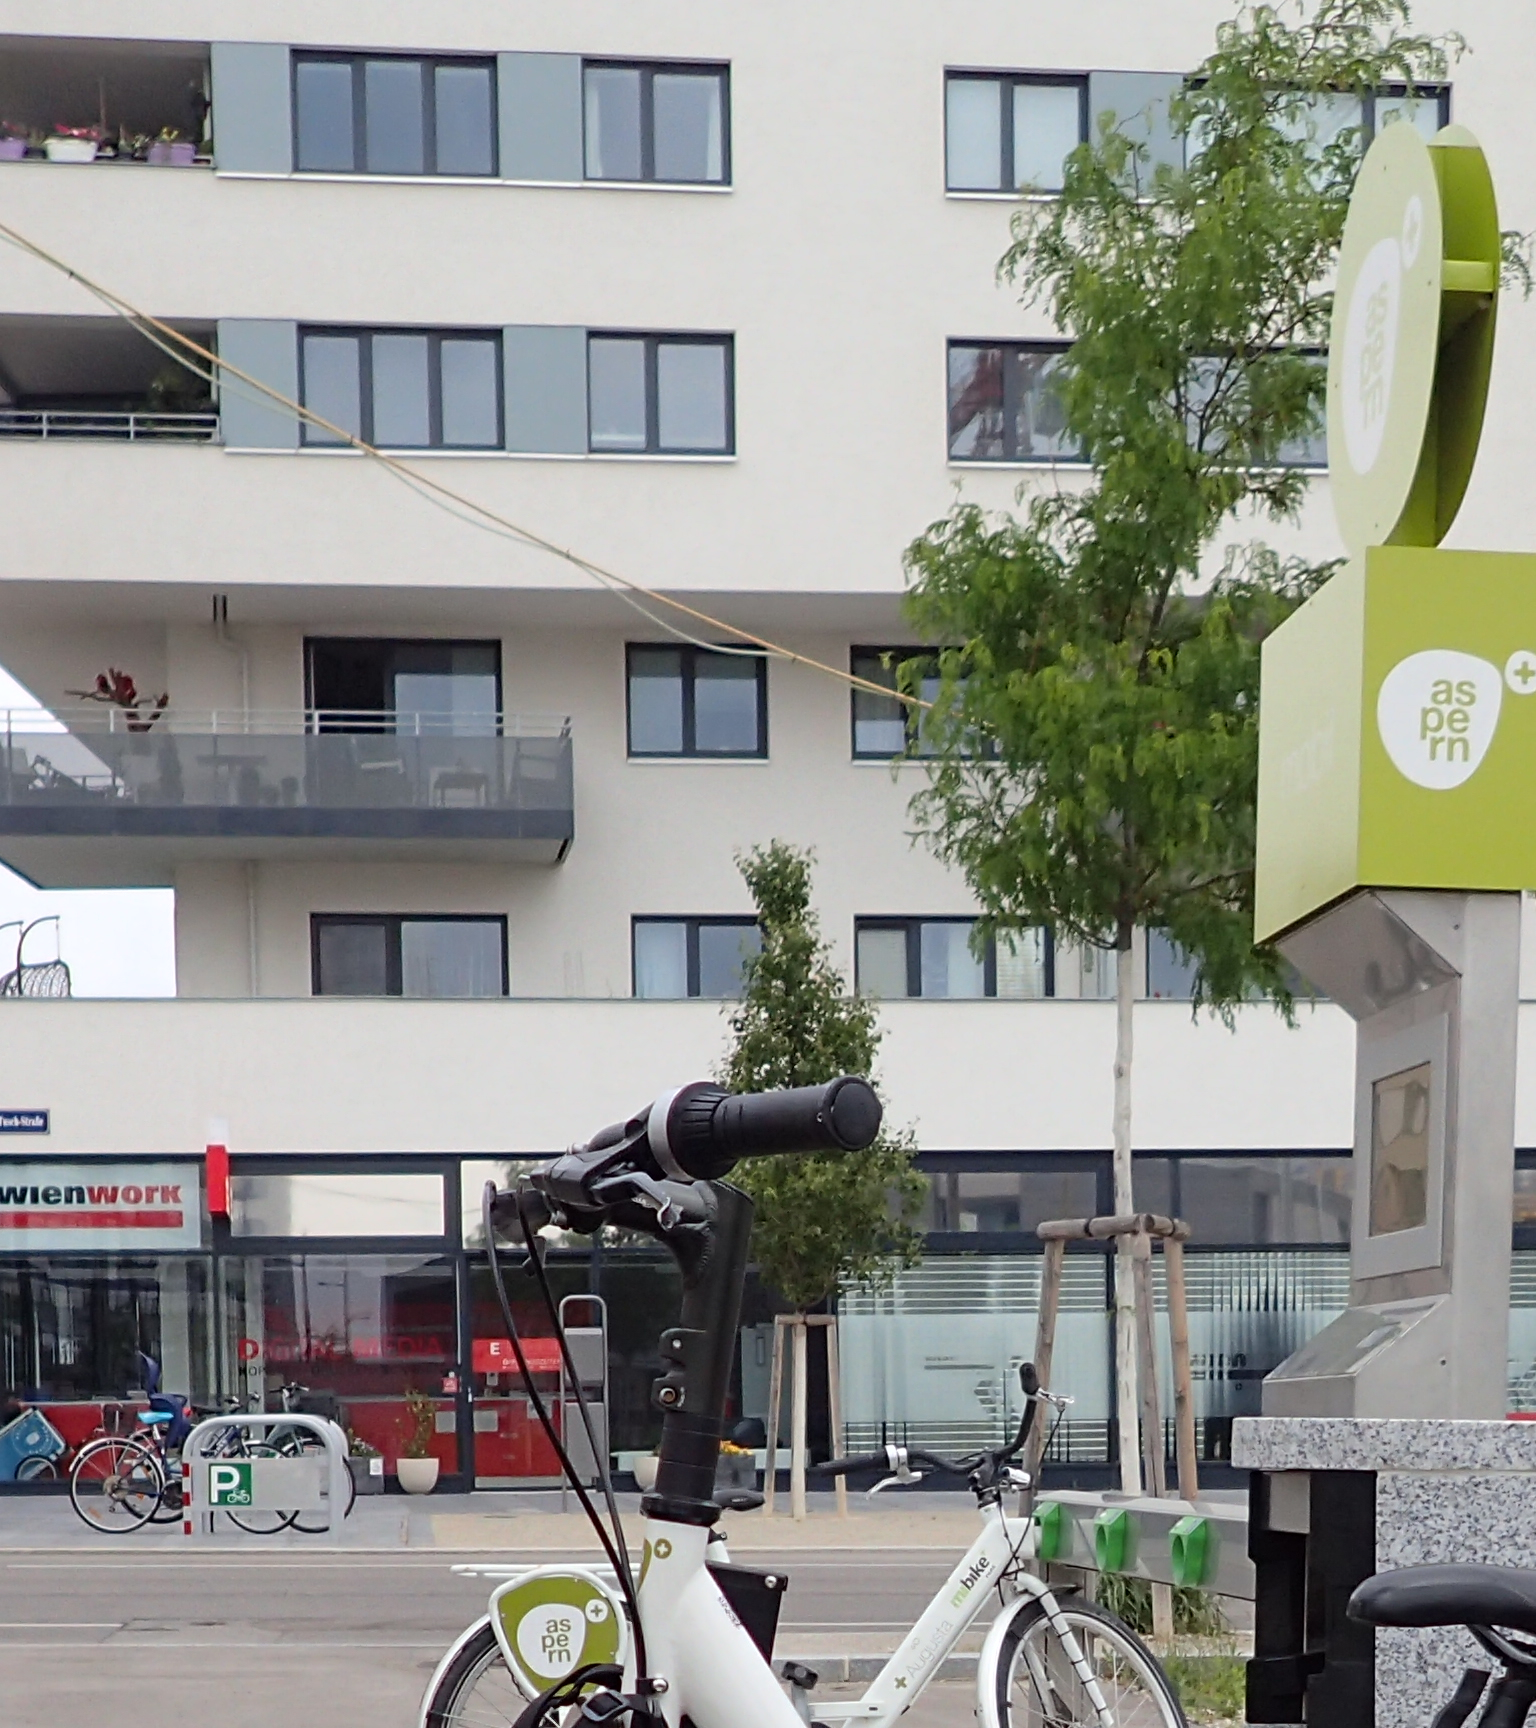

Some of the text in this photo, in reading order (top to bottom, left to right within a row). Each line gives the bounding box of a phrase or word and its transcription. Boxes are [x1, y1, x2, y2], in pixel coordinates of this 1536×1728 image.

[1431, 677, 1476, 706] as
[1420, 707, 1469, 751] pe
[1429, 733, 1469, 762] rn
[352, 1335, 443, 1359] MEDIA
[210, 1465, 240, 1503] P
[545, 1617, 571, 1634] as
[541, 1632, 569, 1653] pe
[548, 1648, 571, 1664] rn
